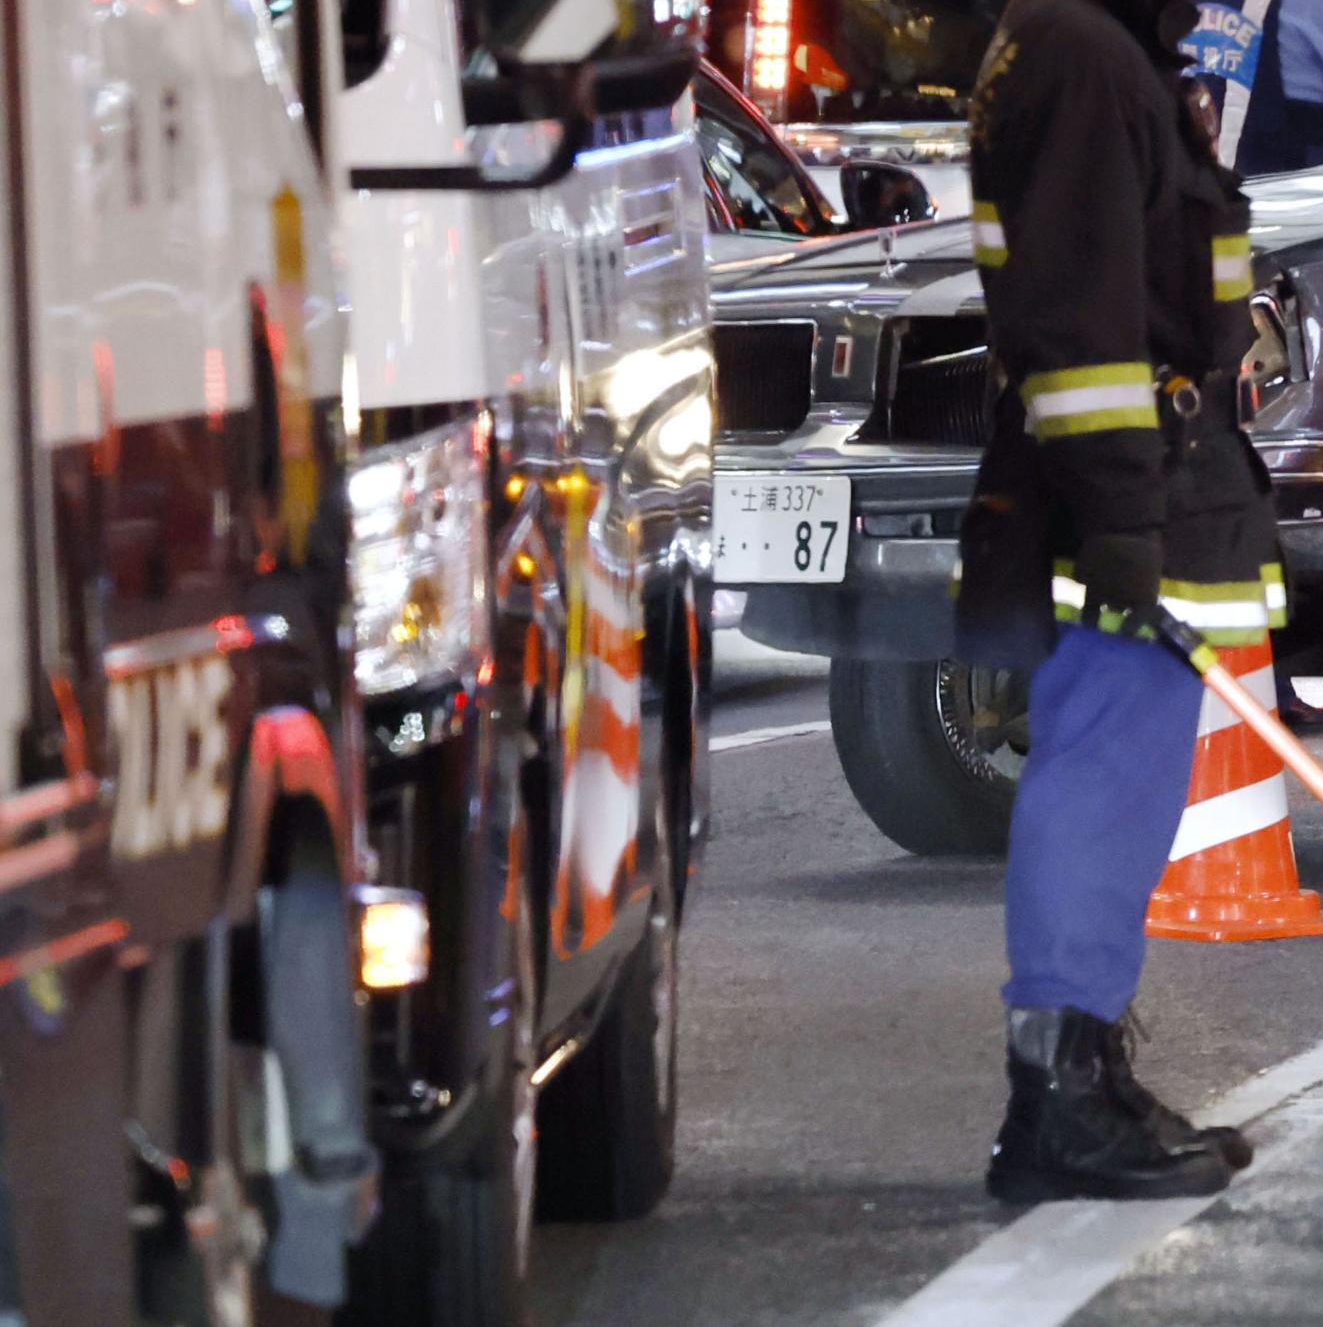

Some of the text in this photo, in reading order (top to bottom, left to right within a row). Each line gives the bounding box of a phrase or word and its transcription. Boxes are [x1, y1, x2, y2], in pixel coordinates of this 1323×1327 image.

[1193, 8, 1257, 50] LICE
[741, 486, 816, 511] 土浦 337
[794, 521, 839, 572] 87
